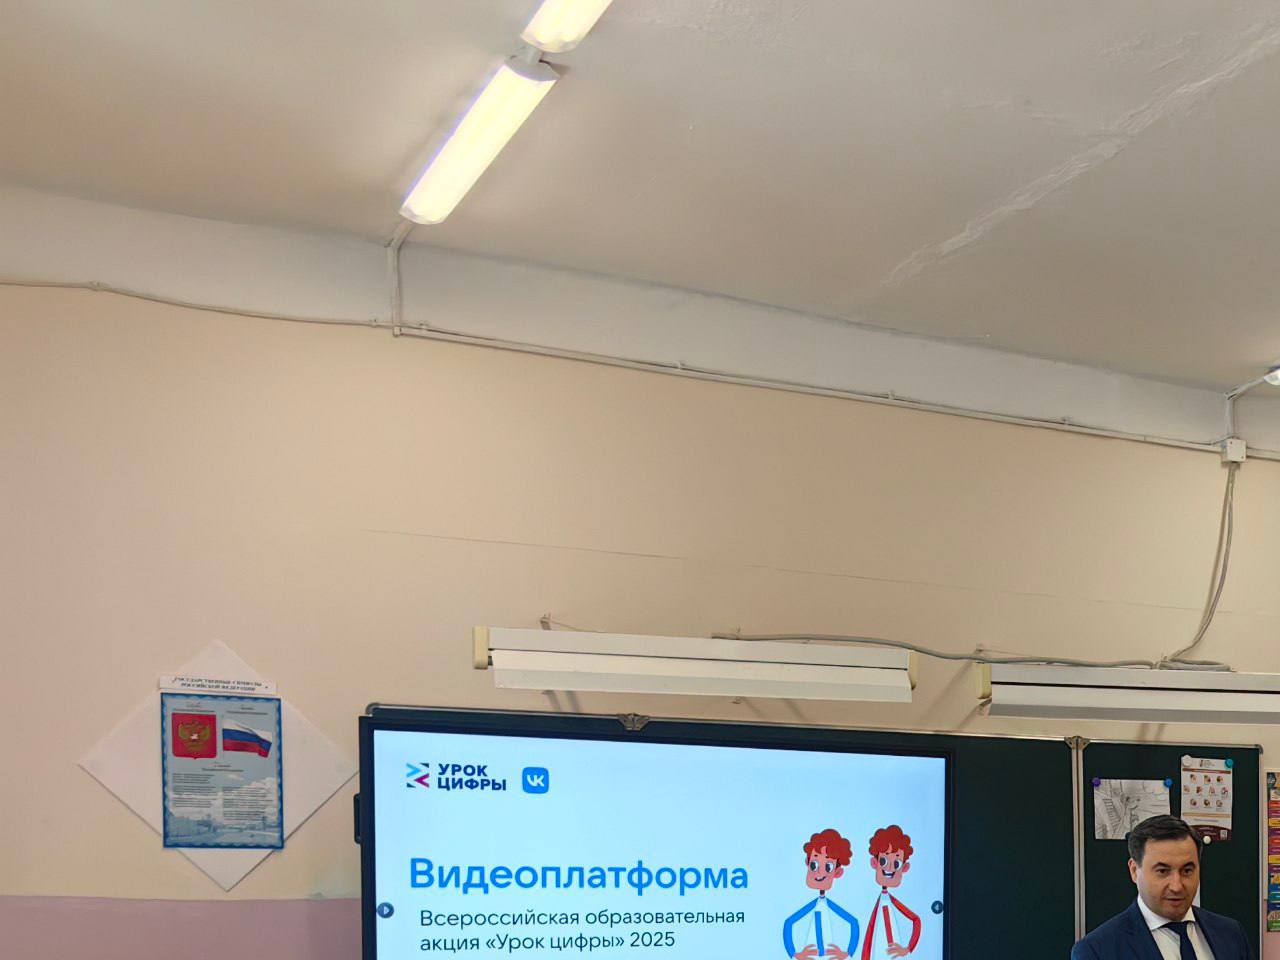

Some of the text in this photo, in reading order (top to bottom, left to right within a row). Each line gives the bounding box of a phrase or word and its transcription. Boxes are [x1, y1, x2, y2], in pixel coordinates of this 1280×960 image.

[438, 763, 488, 777] УРОК
[437, 777, 507, 791] ЦИФРЫ
[409, 857, 749, 896] Видеоплатформа
[420, 908, 745, 930] Всероссийская образовательная
[420, 931, 675, 953] акция «Урок цифры» 2025
